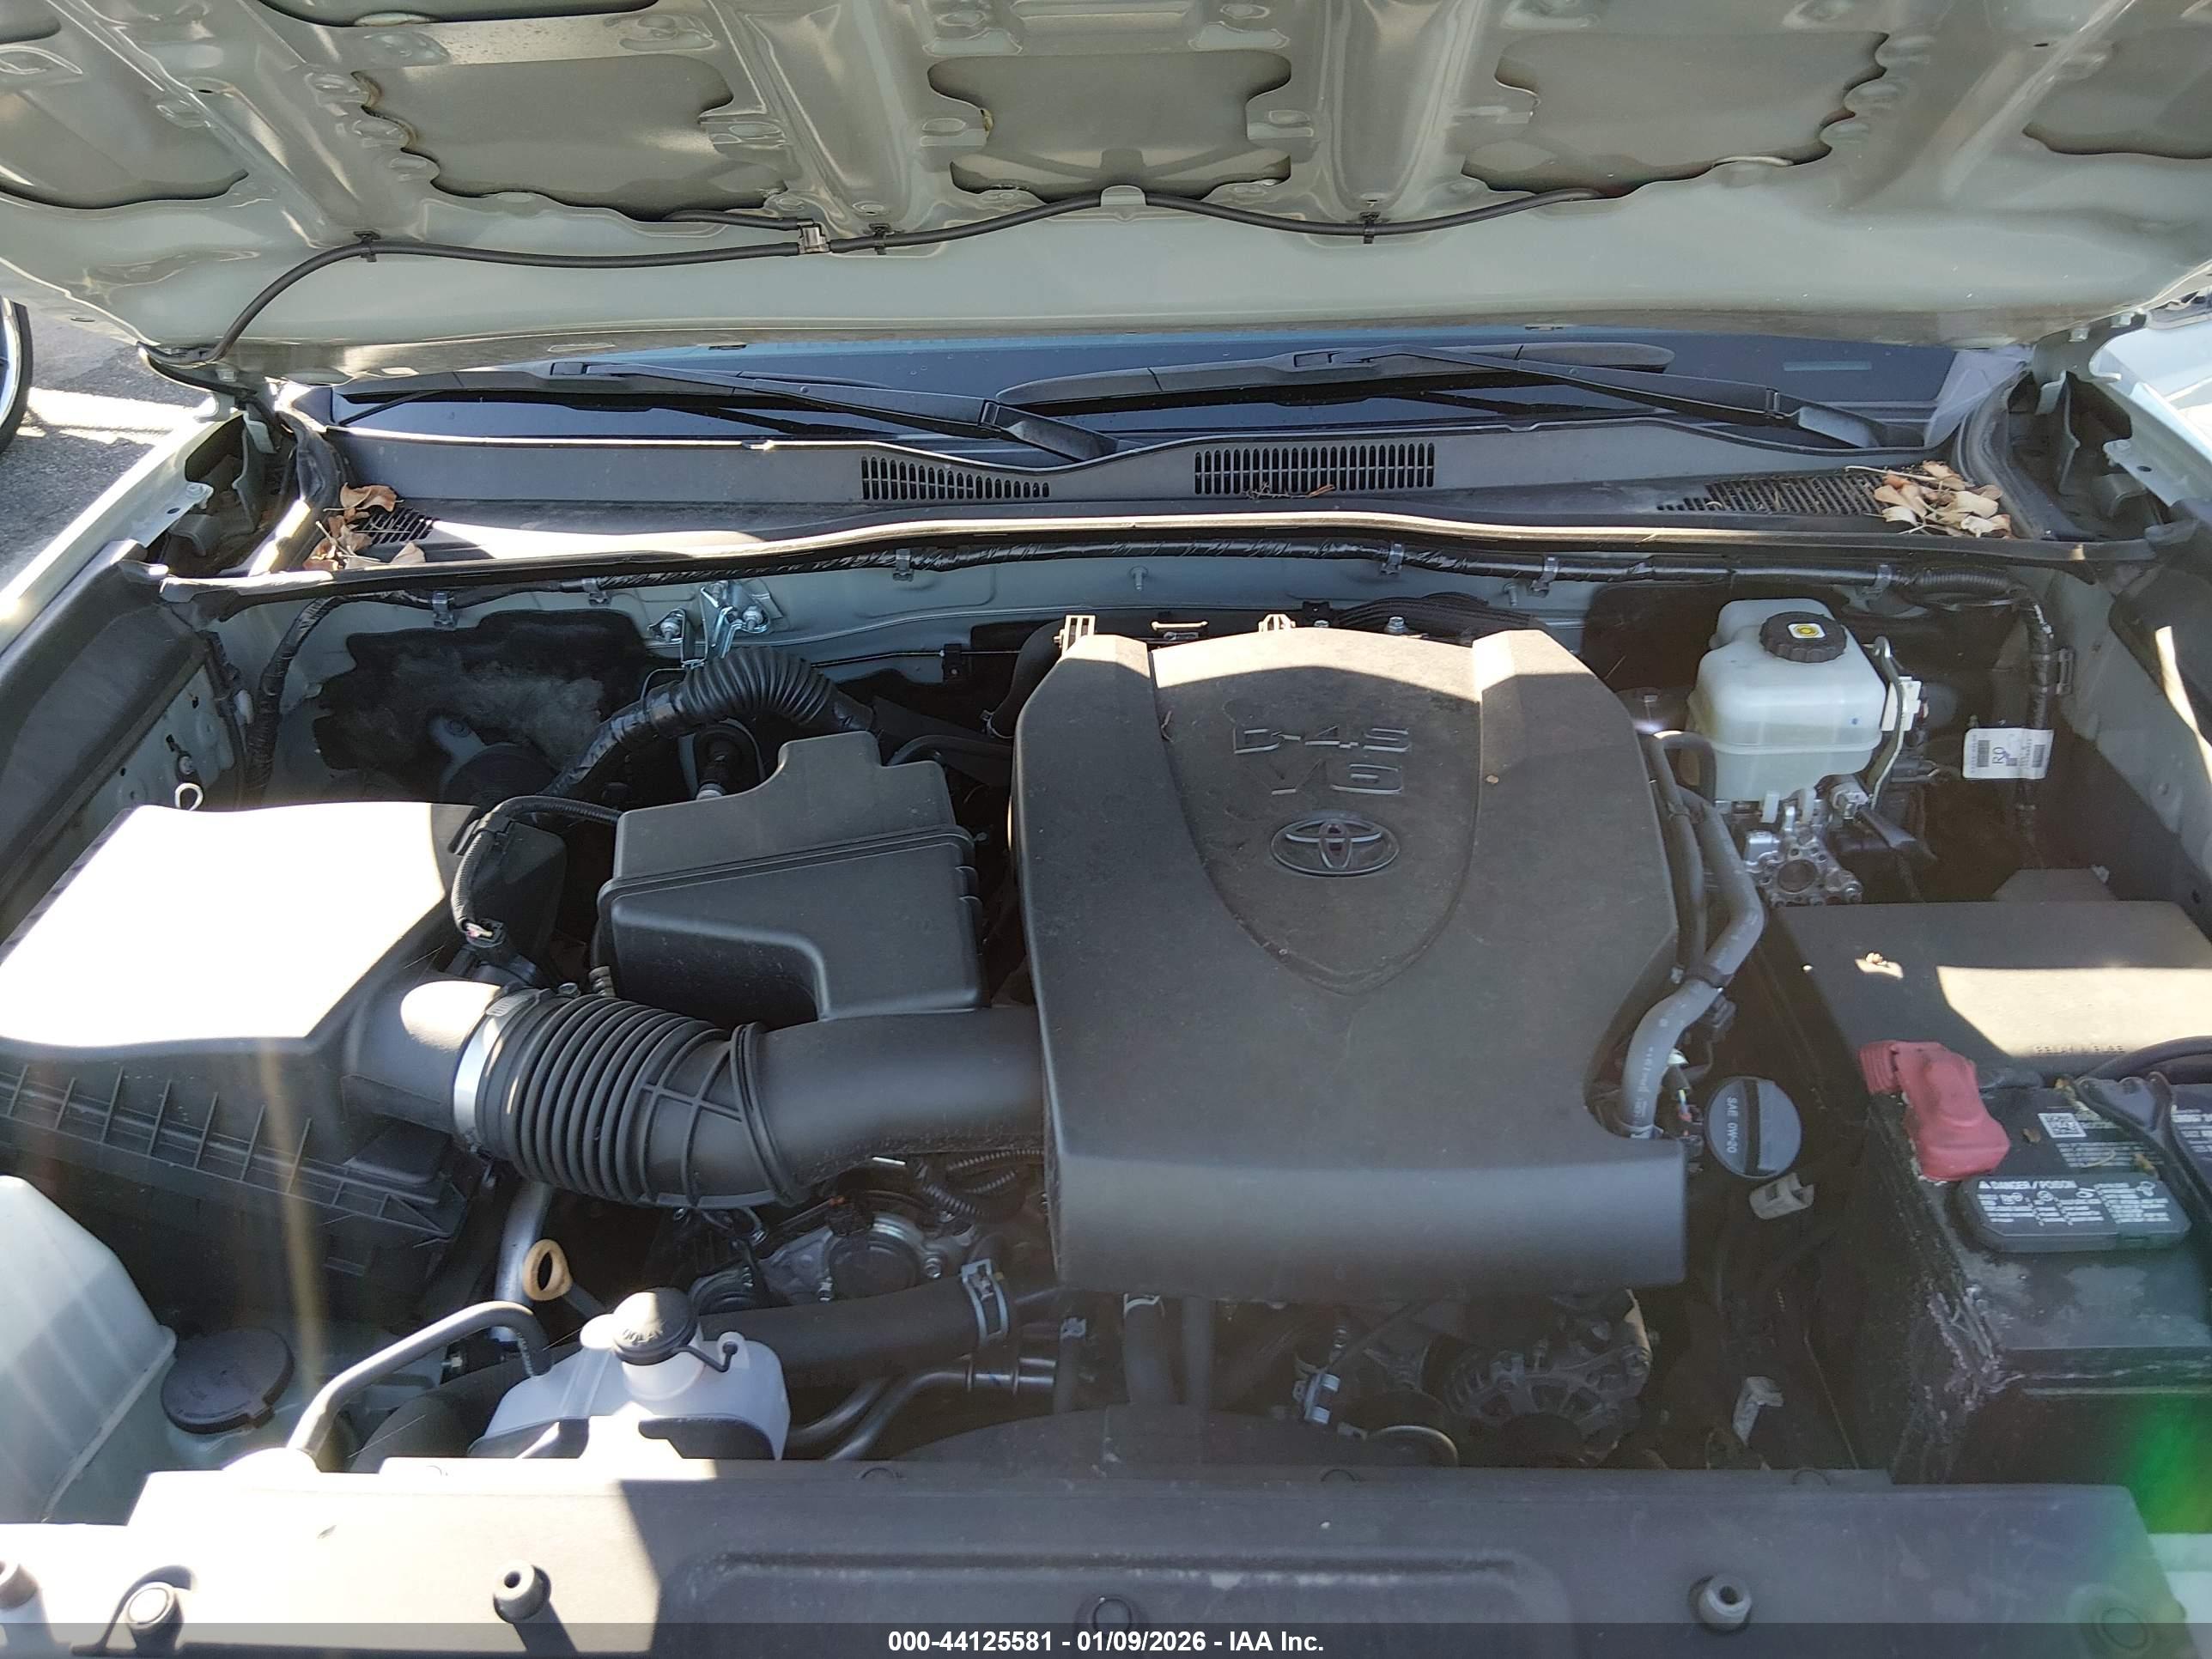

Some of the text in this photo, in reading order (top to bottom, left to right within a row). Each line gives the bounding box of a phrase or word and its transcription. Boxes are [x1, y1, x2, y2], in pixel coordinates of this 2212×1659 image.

[1233, 726, 1412, 755] D-4S
[1247, 759, 1403, 795] V6
[1726, 1097, 1739, 1153] SAE 0W-20
